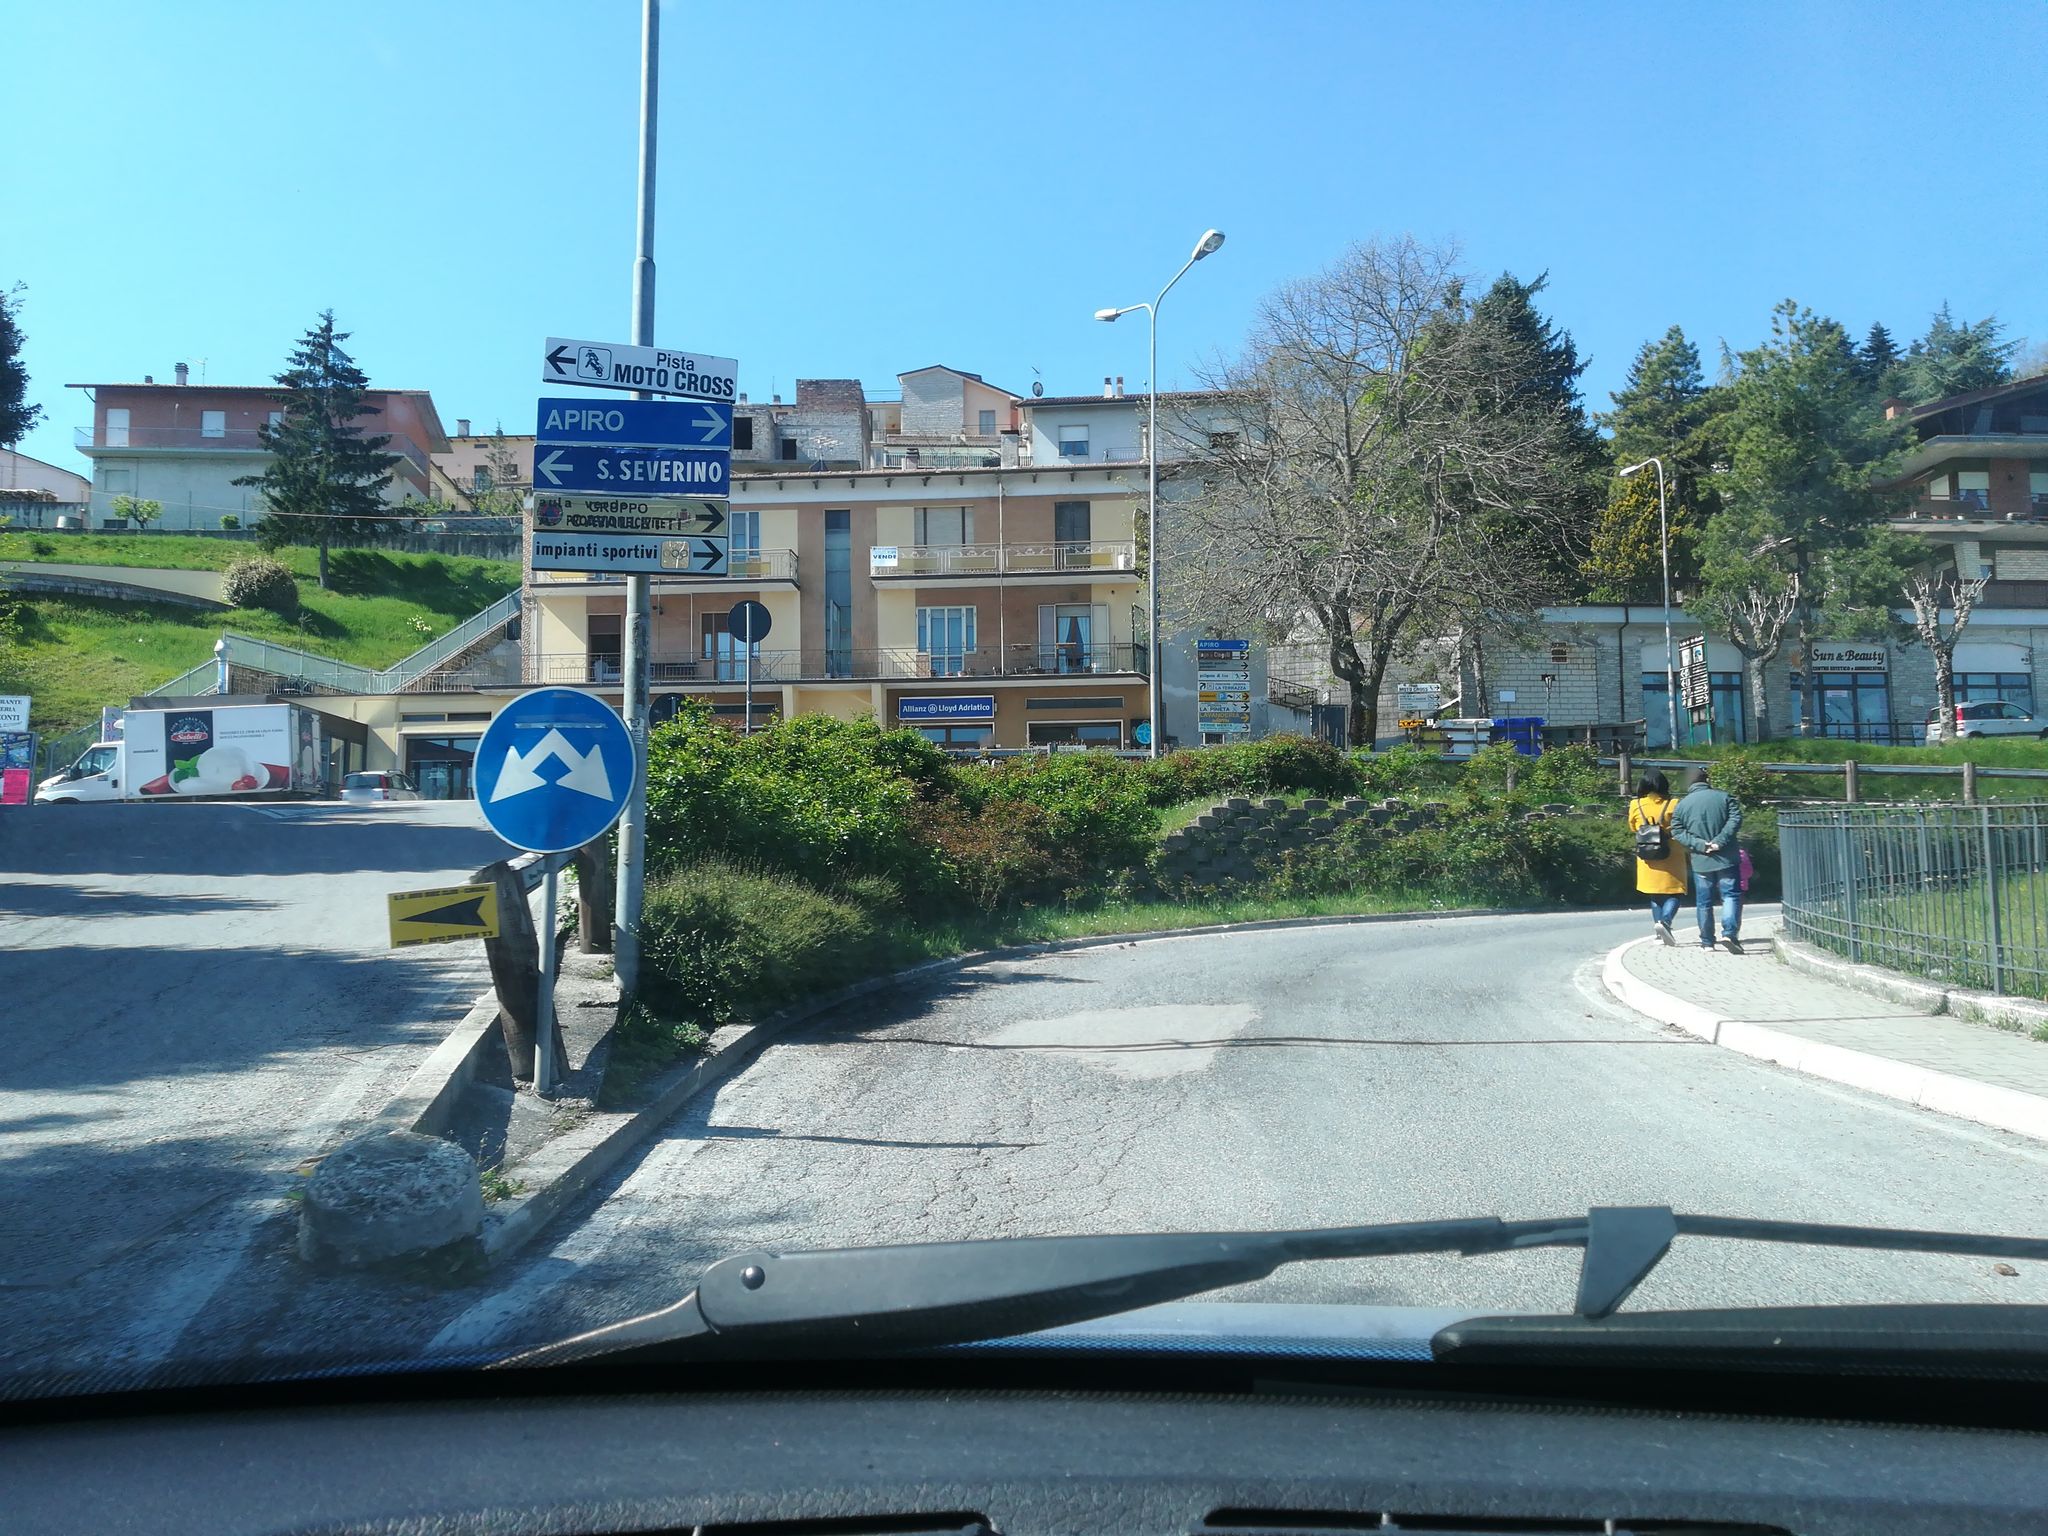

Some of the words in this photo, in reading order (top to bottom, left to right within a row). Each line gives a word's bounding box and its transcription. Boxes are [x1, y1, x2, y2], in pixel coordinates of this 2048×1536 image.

[656, 352, 695, 372] Pista
[614, 363, 668, 388] MOTO
[674, 371, 734, 397] CROSS
[544, 409, 625, 432] APIRO
[535, 541, 597, 560] impianti
[602, 544, 657, 561] sportivi
[1812, 648, 1835, 661] Sun
[1836, 652, 1844, 661] &
[1845, 649, 1885, 665] Beauty
[902, 704, 928, 713] Allianz
[938, 703, 957, 713] Lloyd
[958, 703, 990, 712] Adriatico
